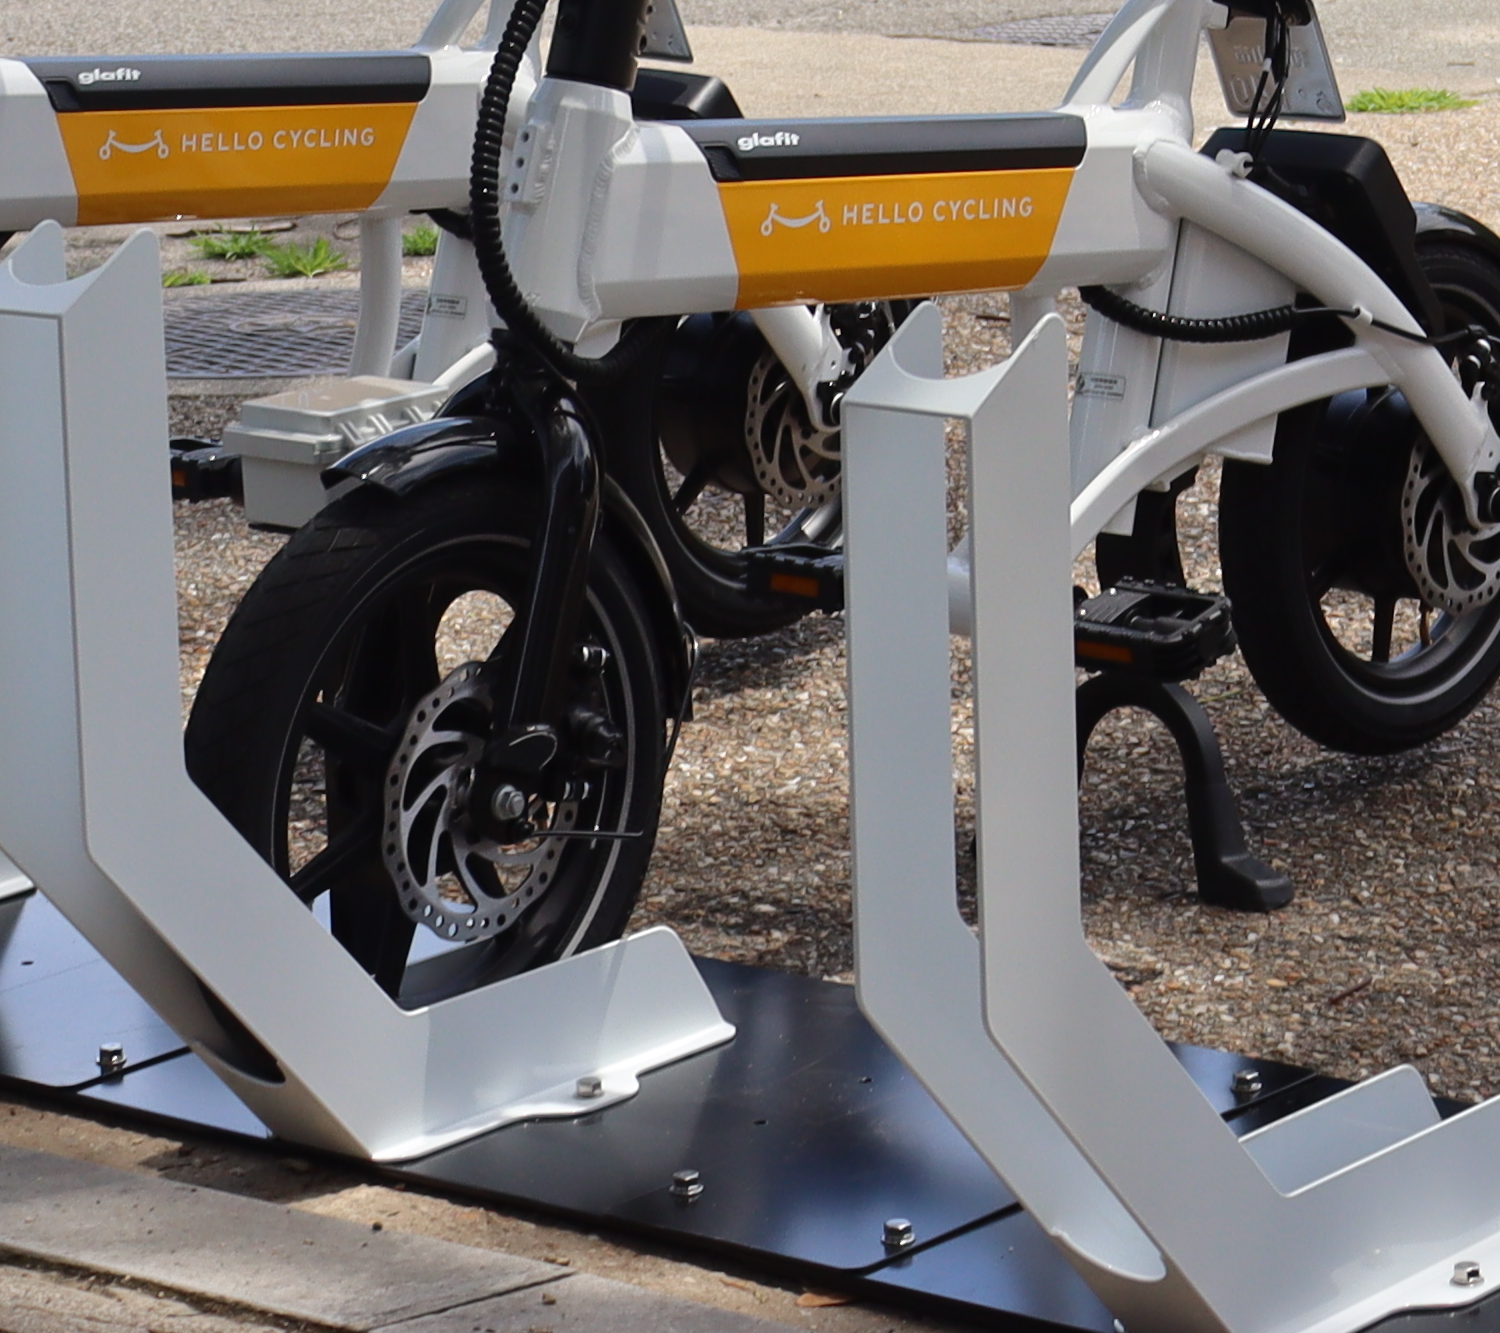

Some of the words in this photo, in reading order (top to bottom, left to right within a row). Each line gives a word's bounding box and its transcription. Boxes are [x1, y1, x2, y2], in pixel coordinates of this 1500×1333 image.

[78, 67, 141, 84] glafit
[181, 131, 263, 152] HELLO
[273, 127, 375, 150] CYCLING
[737, 131, 800, 151] glafit
[842, 200, 924, 226] HELLO
[932, 196, 1034, 222] CYCLING
